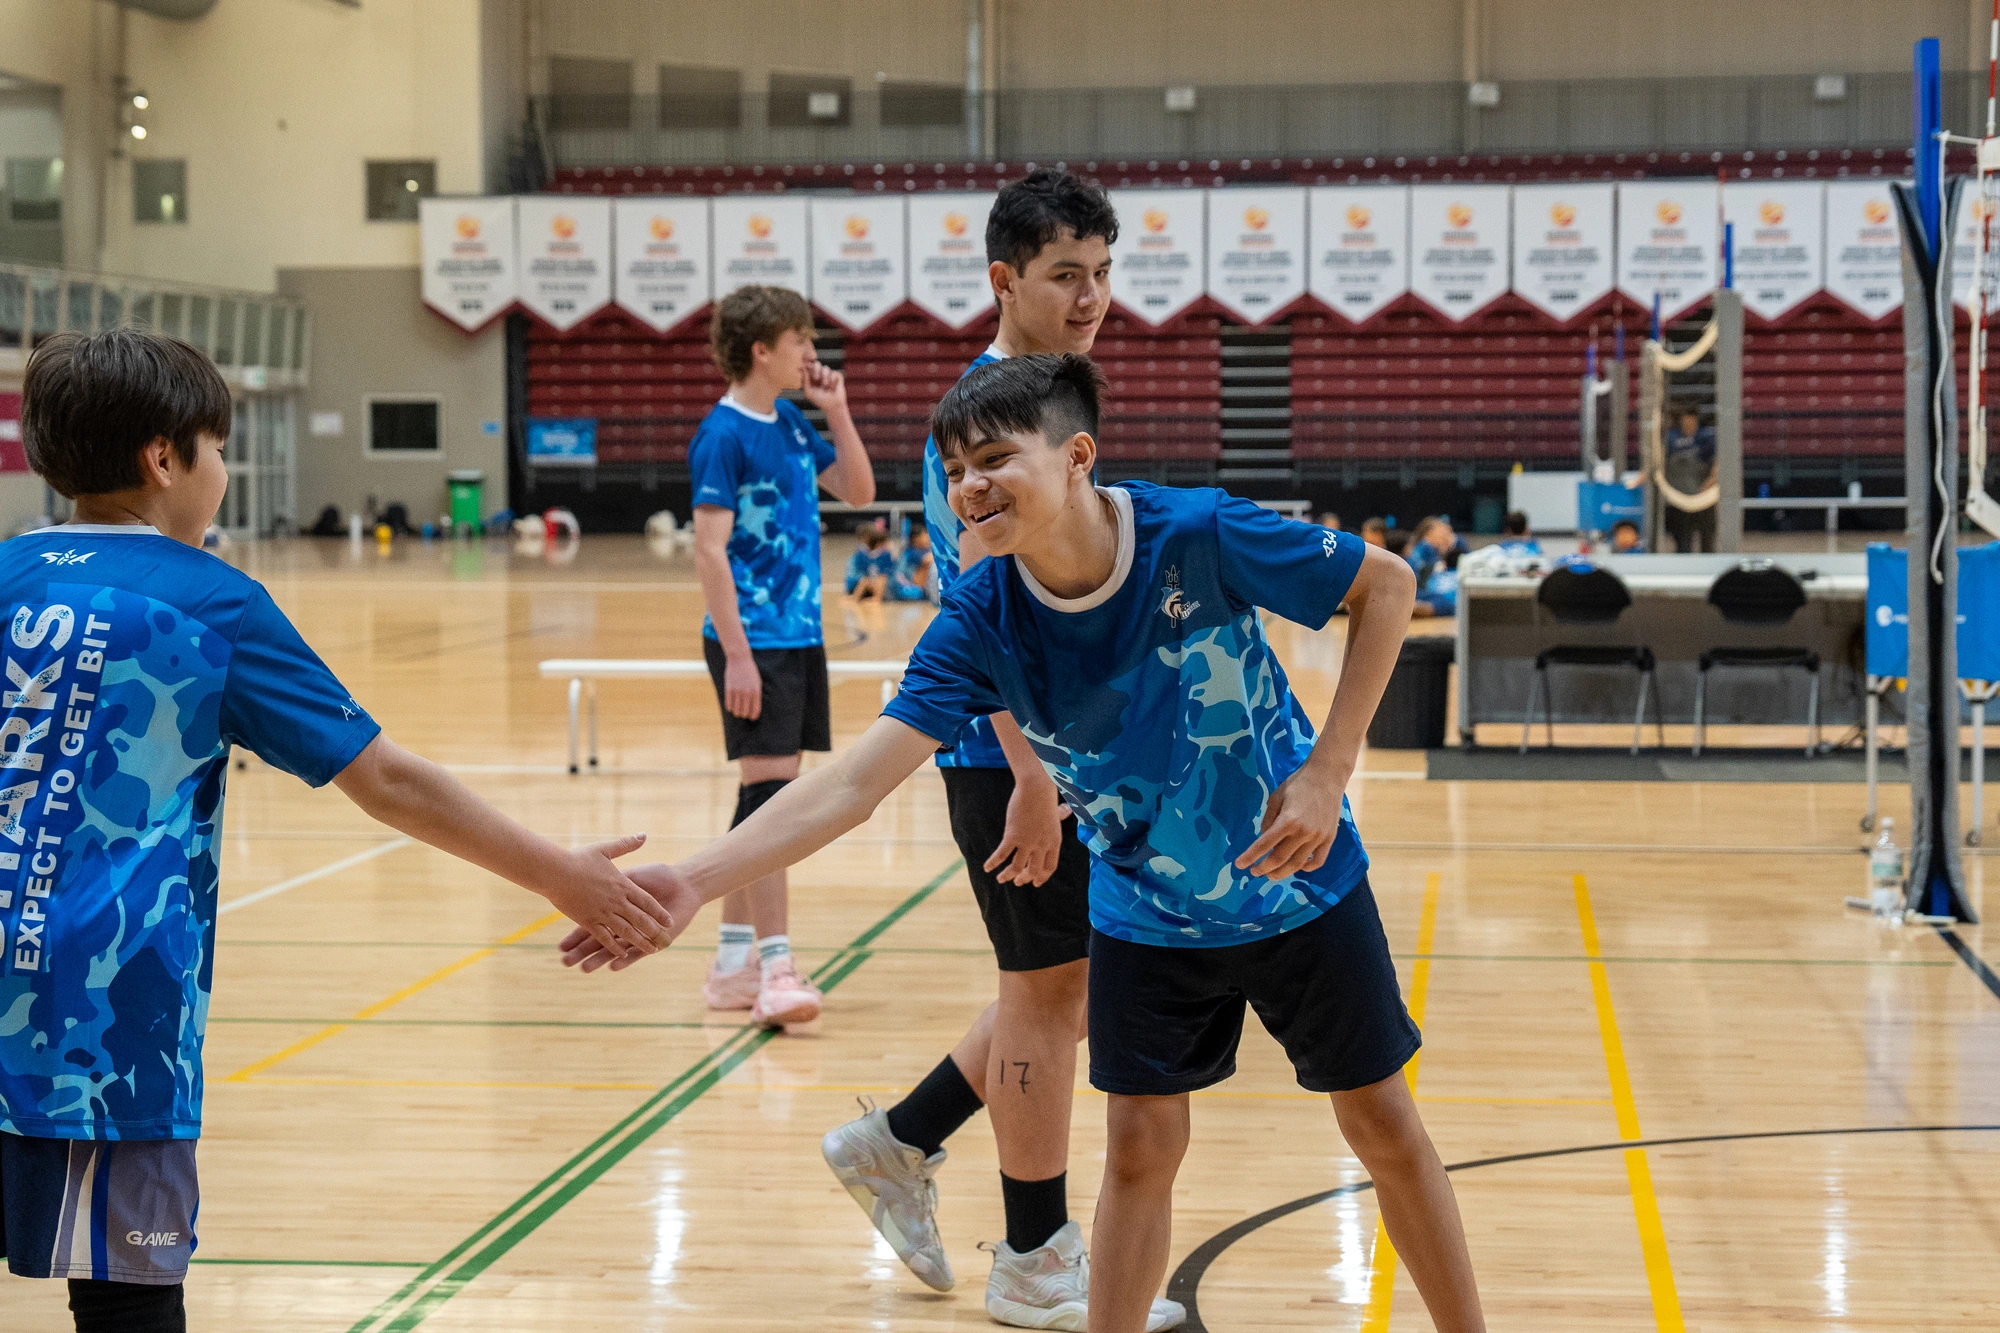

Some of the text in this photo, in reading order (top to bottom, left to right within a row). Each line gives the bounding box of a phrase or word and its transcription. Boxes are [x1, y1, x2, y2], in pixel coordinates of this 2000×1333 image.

[0, 603, 76, 958] ARKS
[14, 613, 113, 972] EXPECT TO GET BIT
[1001, 1059, 1031, 1094] 17
[125, 1230, 180, 1247] GAME
